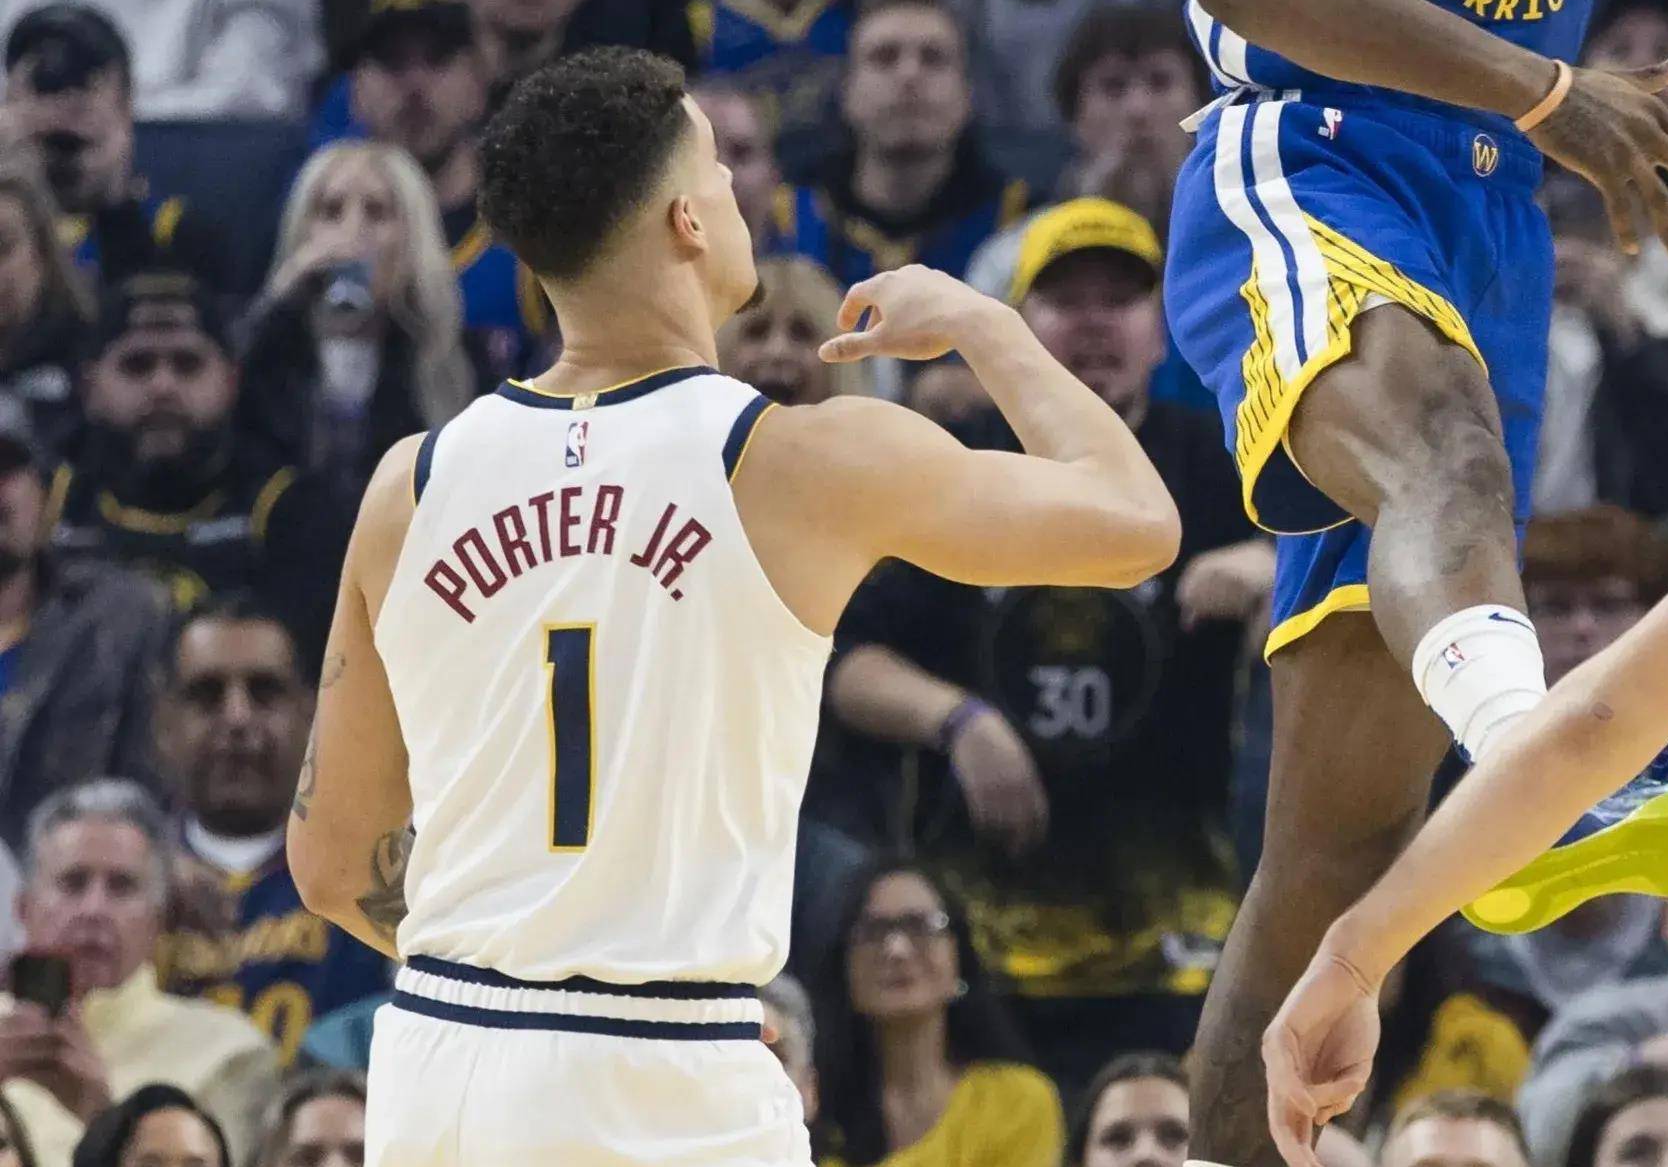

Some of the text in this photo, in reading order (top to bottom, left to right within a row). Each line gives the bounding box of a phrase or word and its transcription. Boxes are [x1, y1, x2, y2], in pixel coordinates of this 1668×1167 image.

[424, 485, 713, 624] PORTER JR.
[541, 619, 598, 854] 1
[1026, 664, 1112, 738] 30
